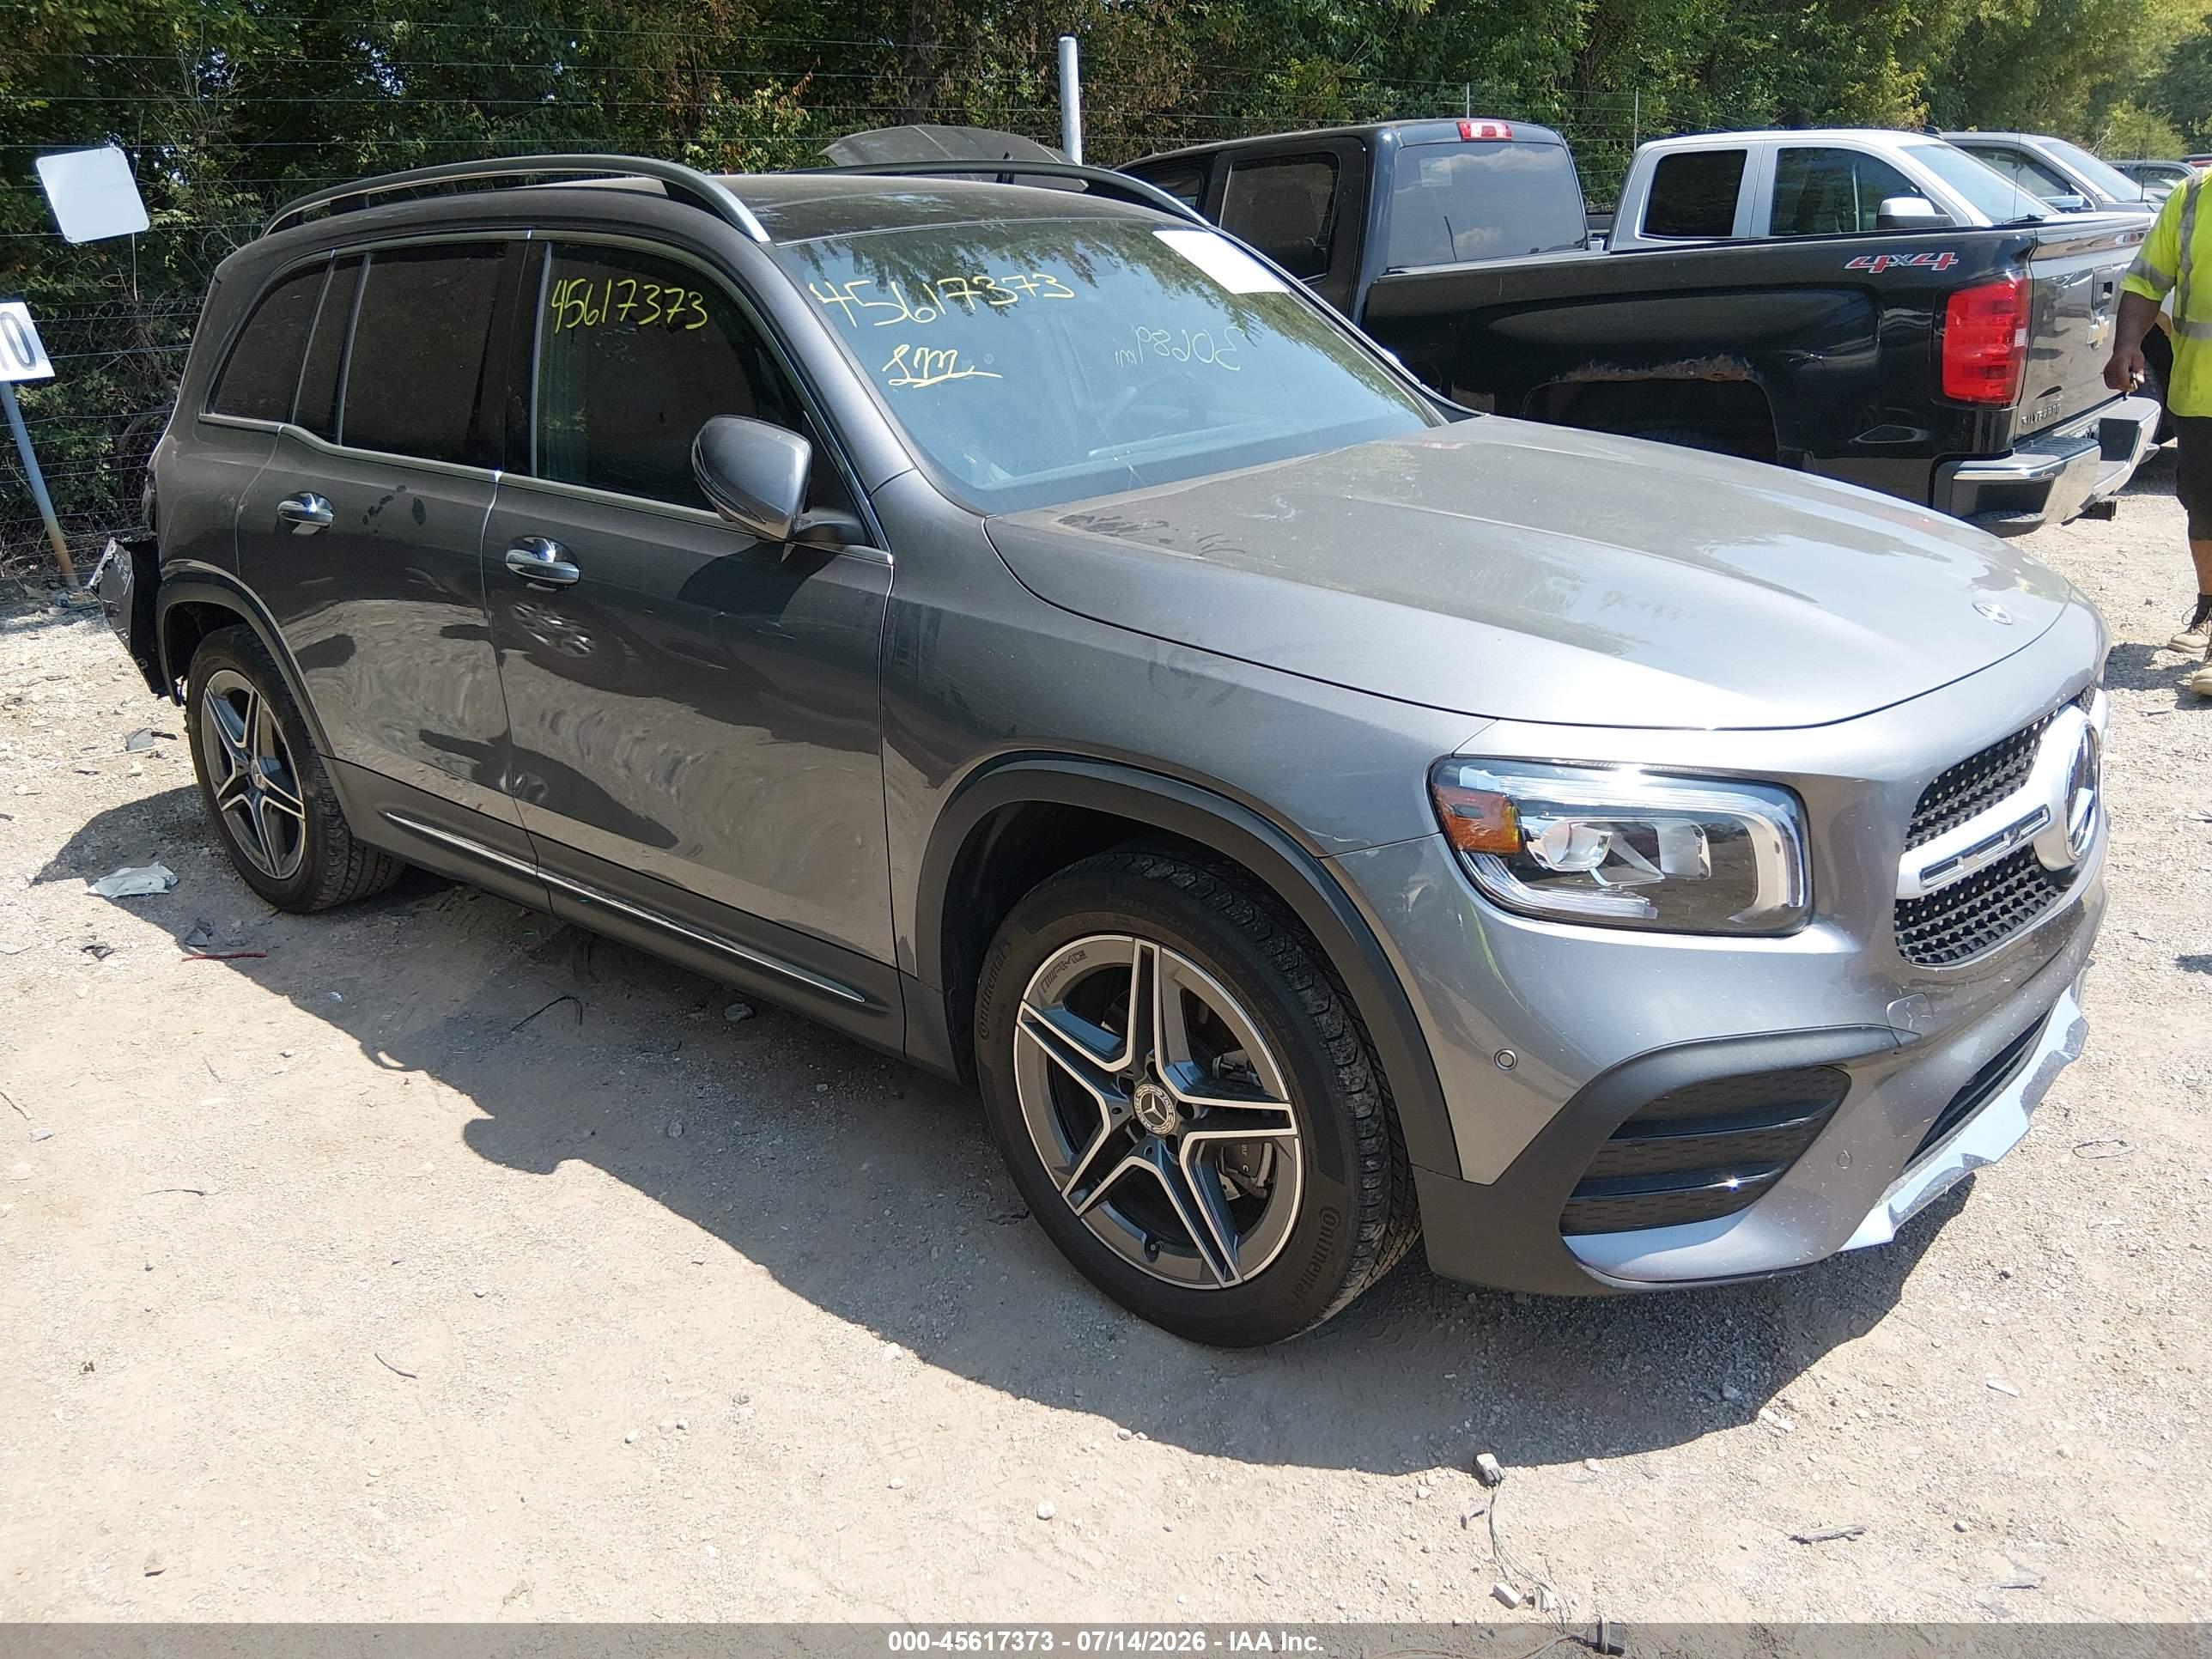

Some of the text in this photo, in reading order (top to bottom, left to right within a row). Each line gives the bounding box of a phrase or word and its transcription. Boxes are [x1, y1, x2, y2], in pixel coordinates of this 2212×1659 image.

[1844, 252, 1959, 273] 4x4
[551, 278, 708, 334] 45617373
[809, 273, 1075, 327] 45617373
